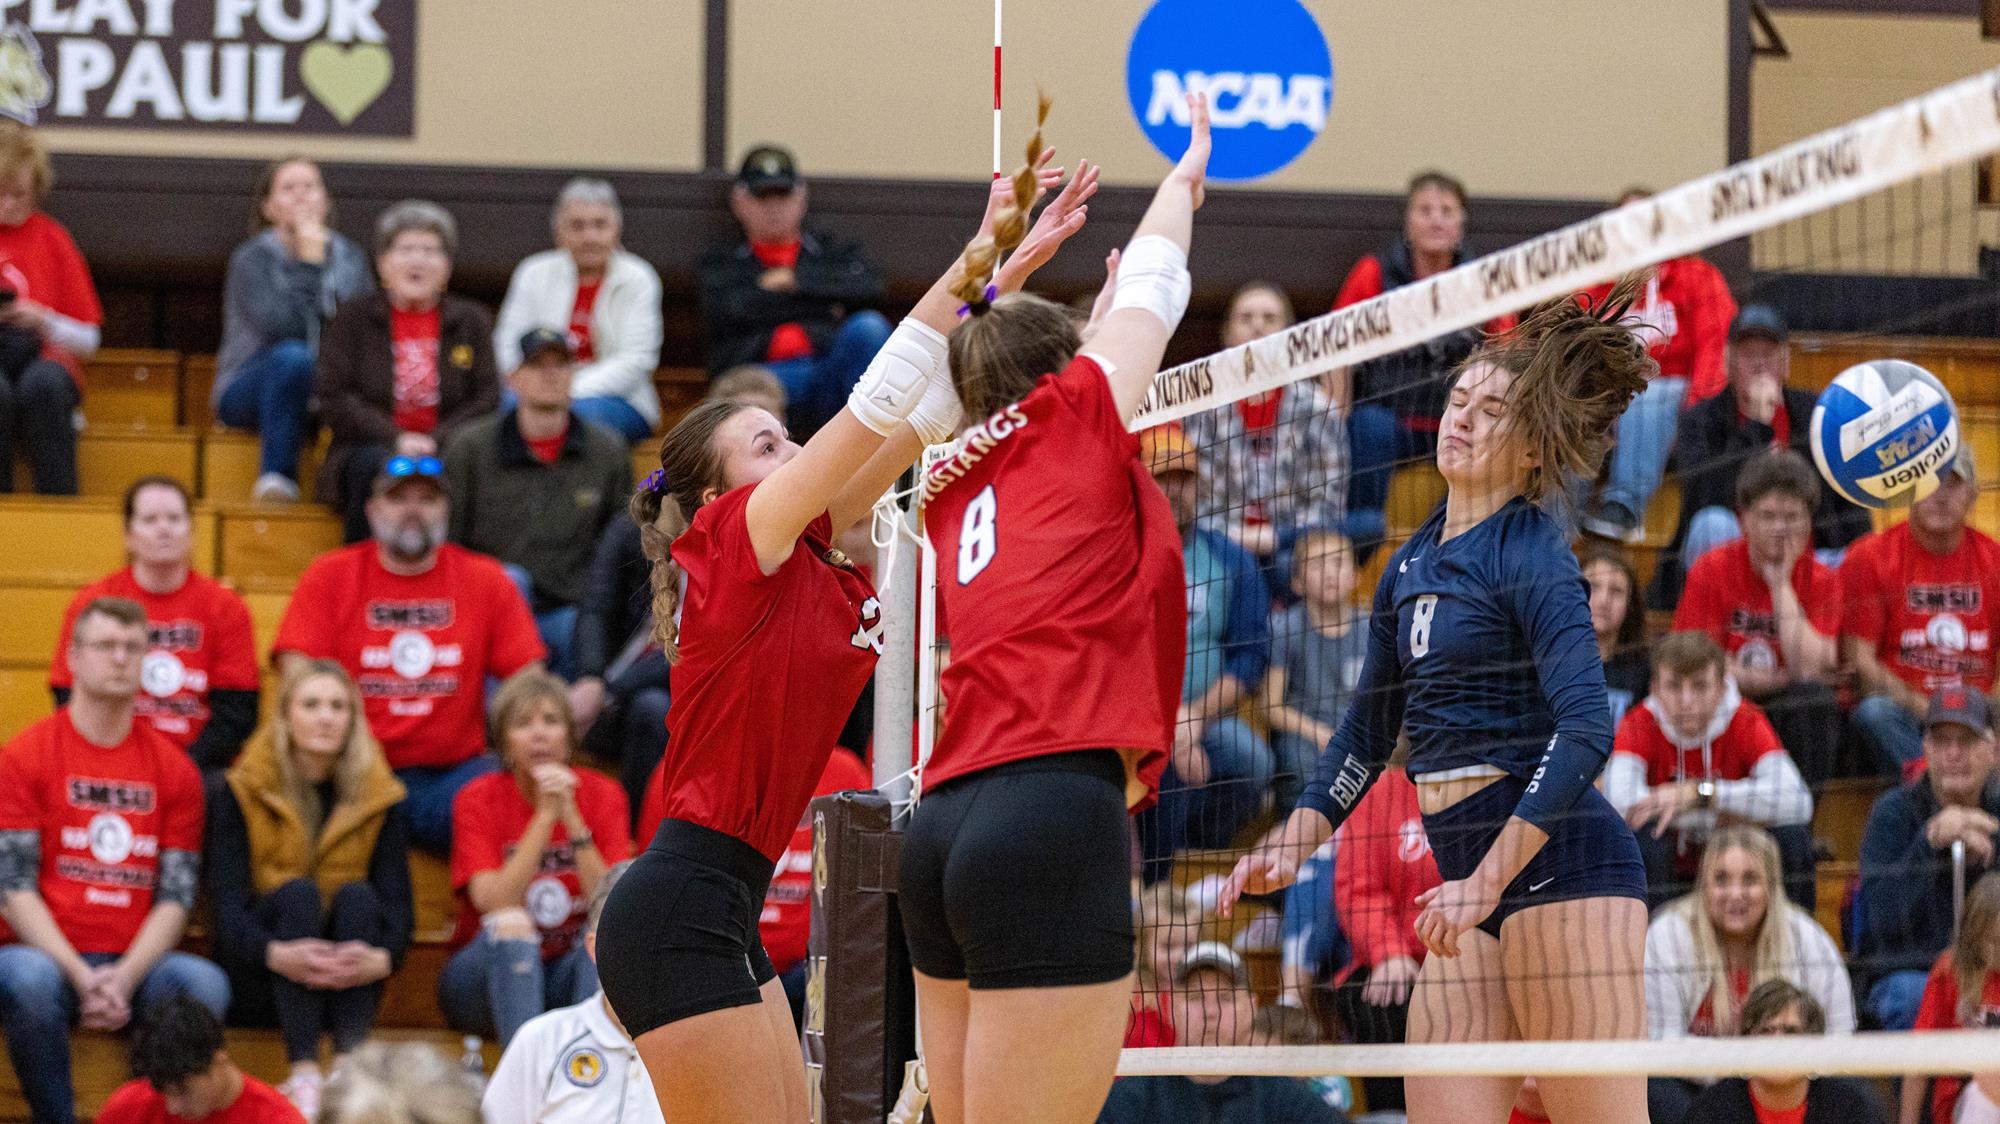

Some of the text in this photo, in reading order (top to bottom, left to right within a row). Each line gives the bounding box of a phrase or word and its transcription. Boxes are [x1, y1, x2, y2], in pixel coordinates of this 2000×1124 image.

[55, 37, 306, 123] PAUL
[1145, 68, 1327, 133] NCAA
[1875, 413, 1938, 470] NCAA
[1881, 435, 1951, 489] molten
[957, 482, 998, 586] 8
[1410, 594, 1438, 658] 8
[69, 777, 155, 813] SMSU
[1328, 752, 1370, 810] GOLD
